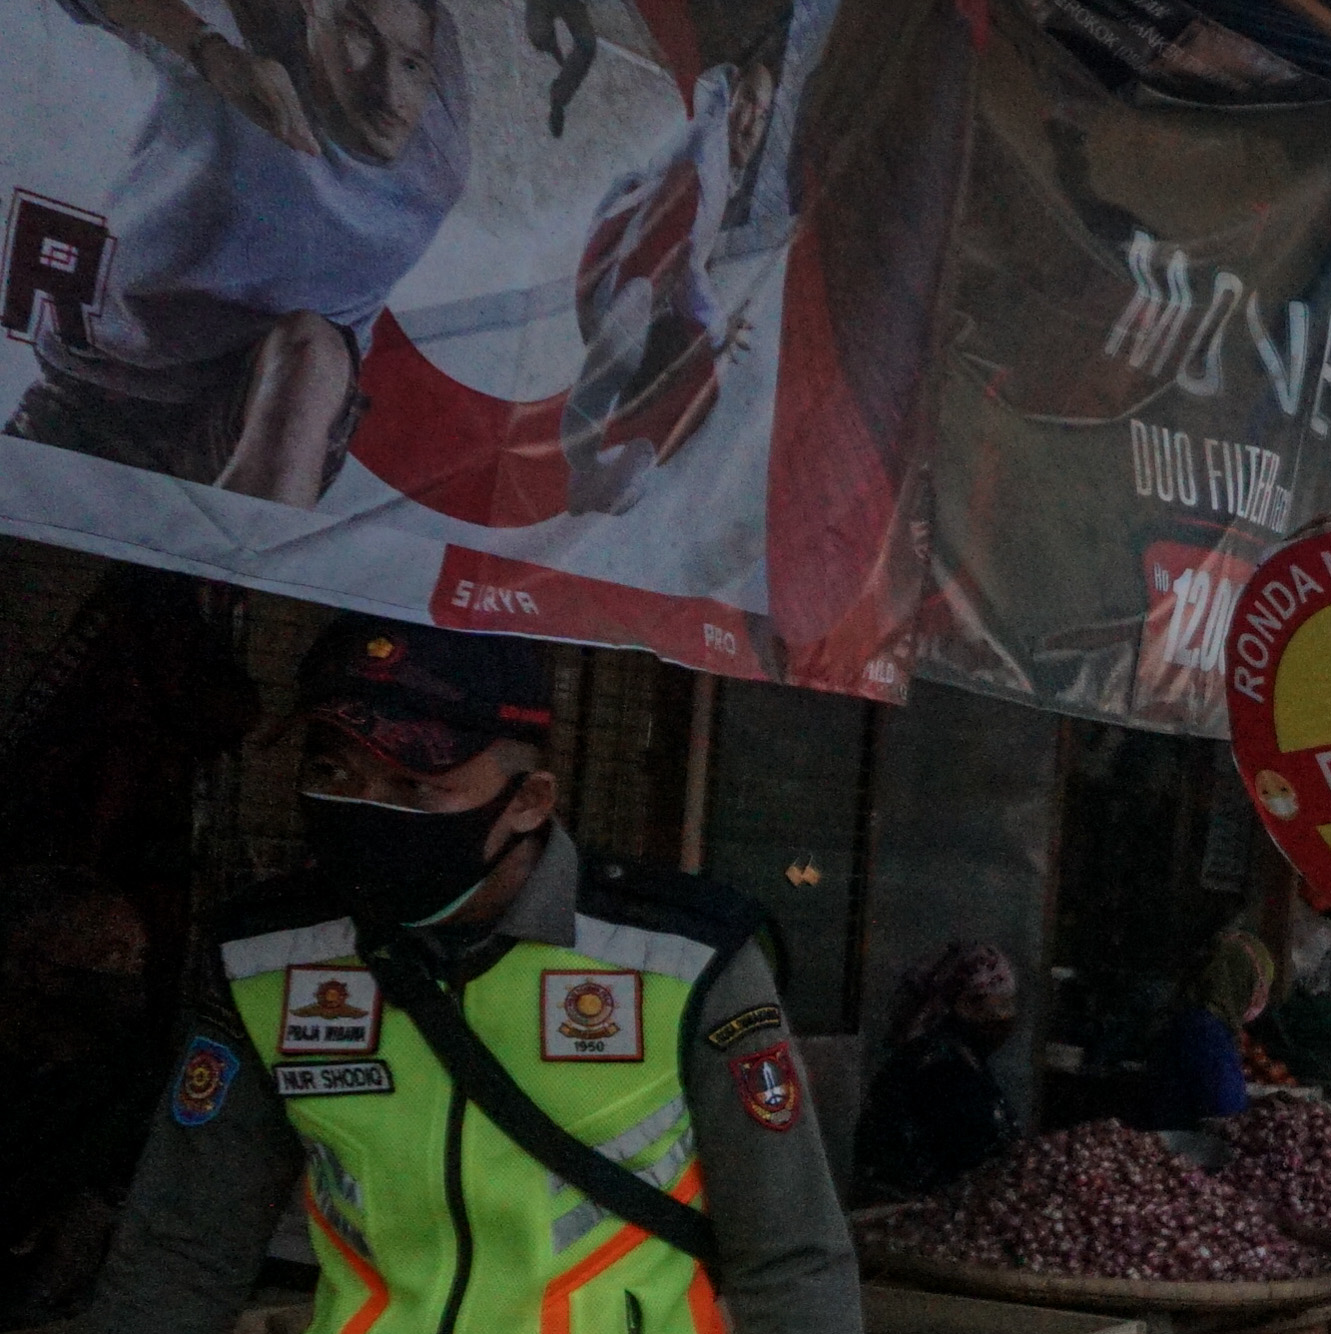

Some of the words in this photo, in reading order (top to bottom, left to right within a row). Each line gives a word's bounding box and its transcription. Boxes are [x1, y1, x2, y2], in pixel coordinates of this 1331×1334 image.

[1130, 418, 1197, 507] DUO
[1203, 437, 1280, 526] FILTER
[703, 622, 736, 655] PRO
[1234, 564, 1323, 703] RONDA
[574, 1040, 605, 1052] 1950
[283, 1070, 317, 1090] NUR
